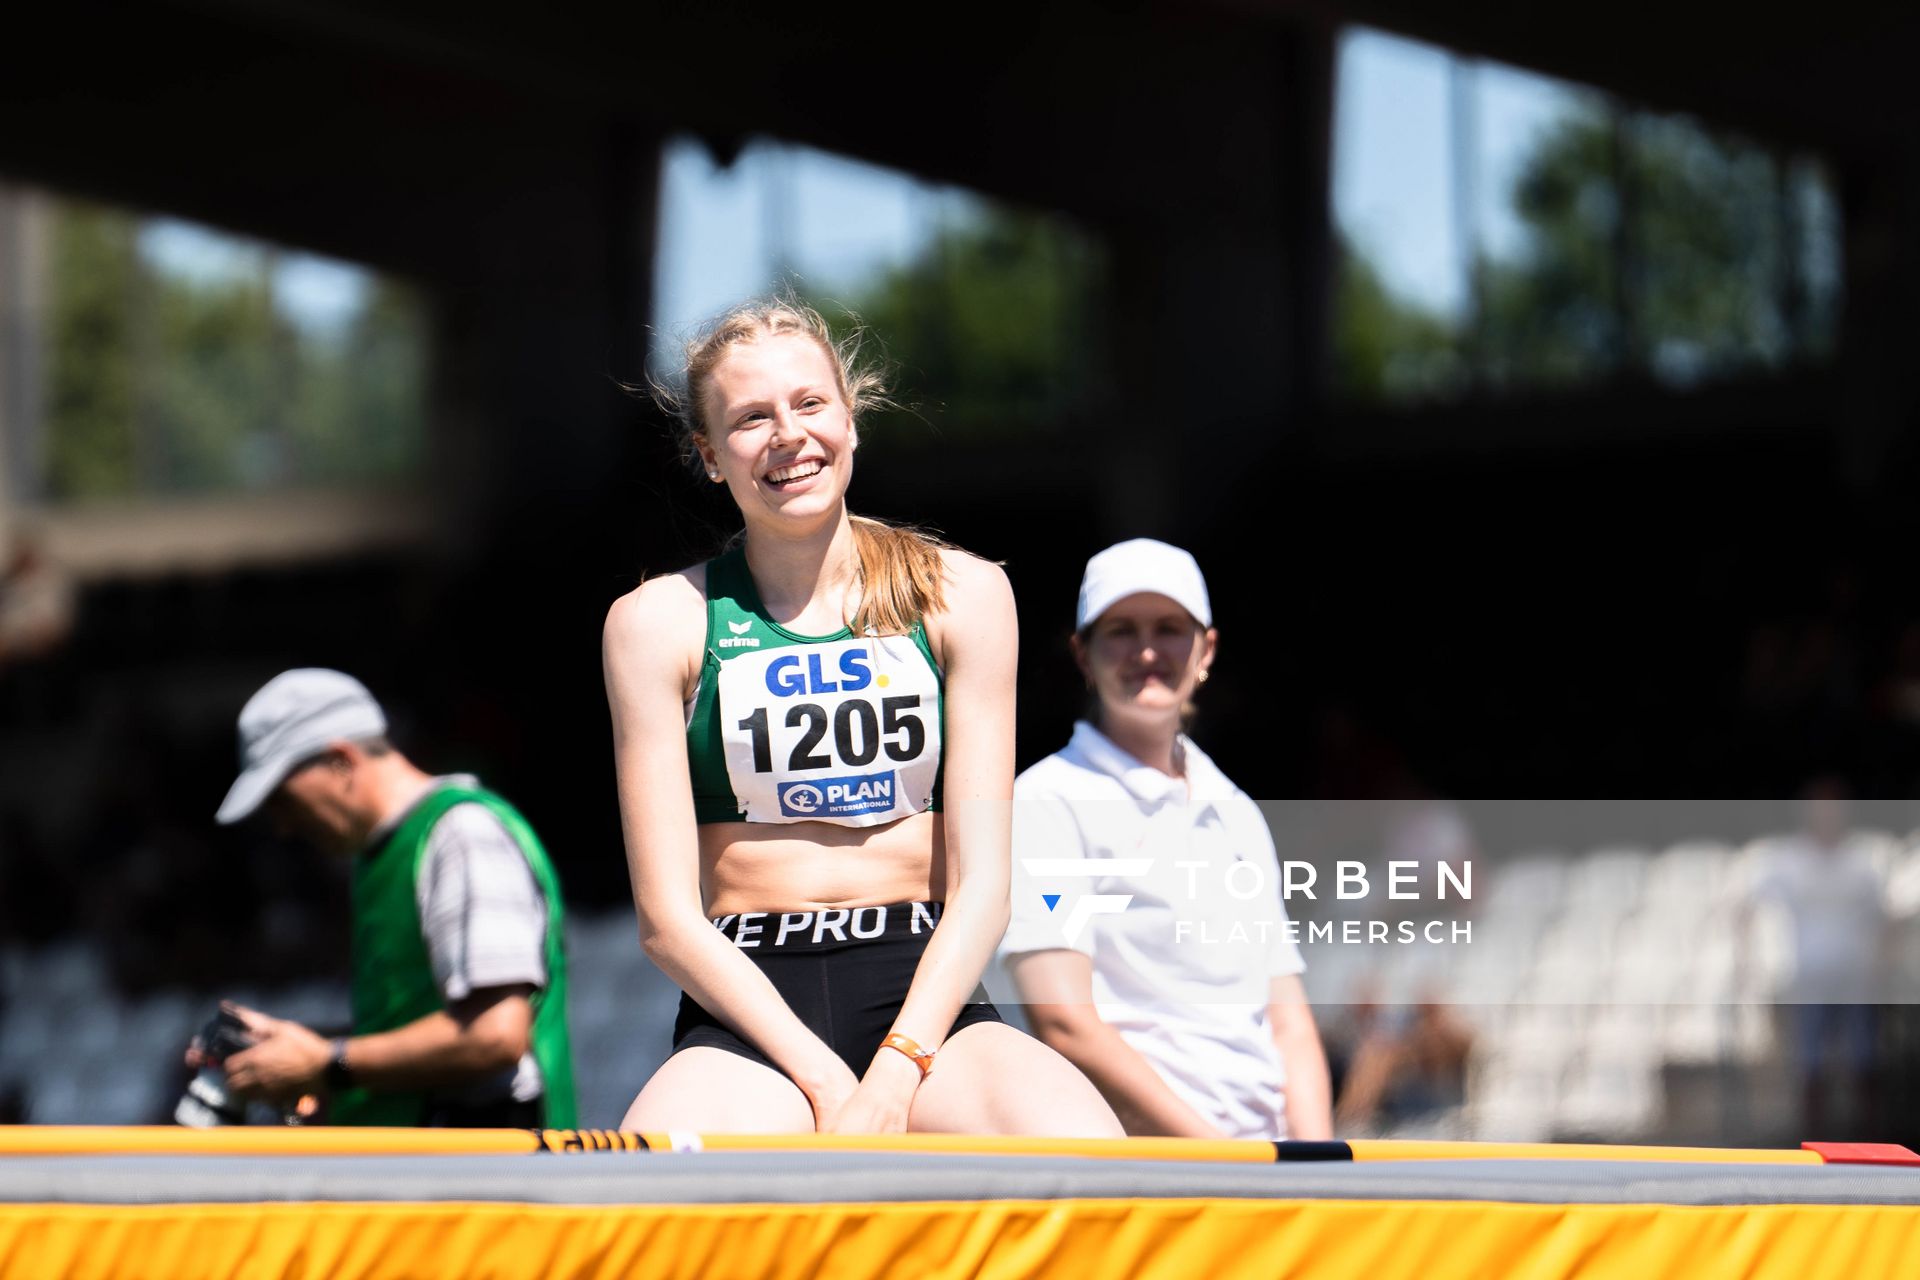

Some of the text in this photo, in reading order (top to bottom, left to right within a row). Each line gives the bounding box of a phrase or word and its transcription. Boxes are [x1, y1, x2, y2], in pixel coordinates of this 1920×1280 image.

[719, 636, 760, 648] erima
[738, 694, 925, 773] 1205
[827, 779, 891, 803] PLAN
[829, 800, 891, 812] INTERNATIONAL
[774, 906, 888, 946] PRO
